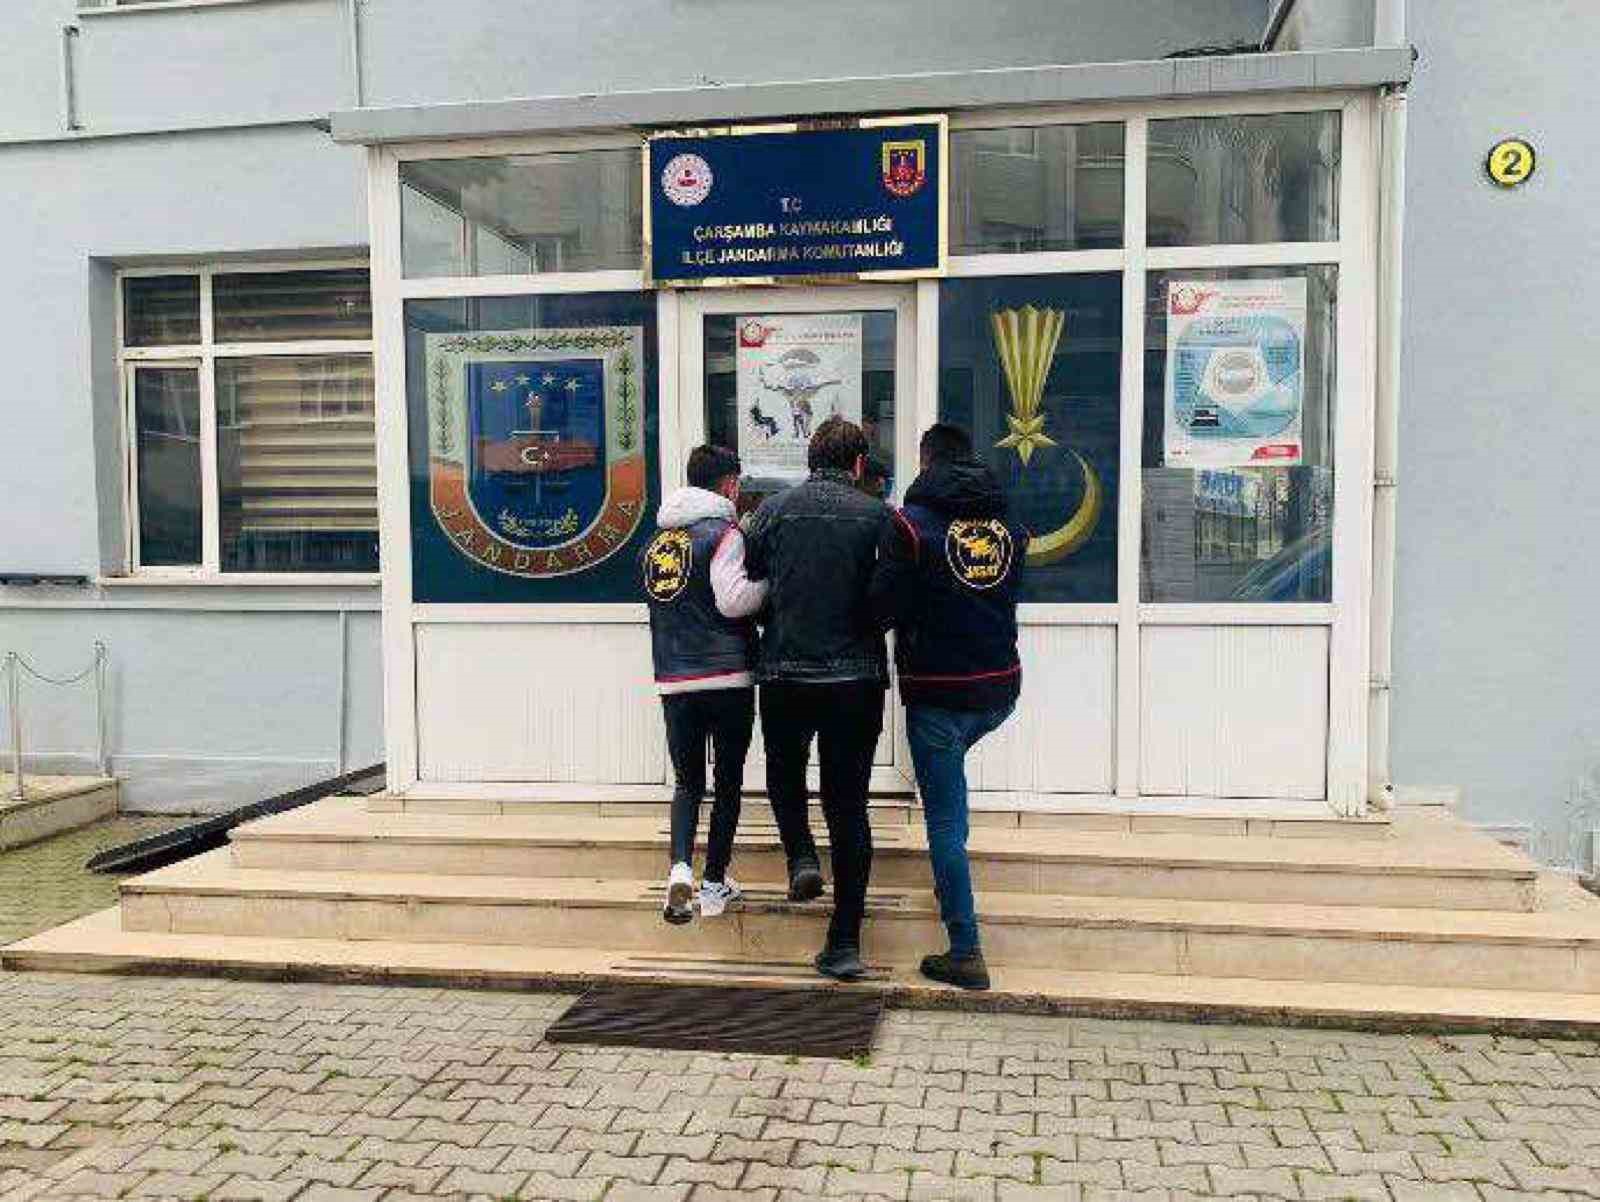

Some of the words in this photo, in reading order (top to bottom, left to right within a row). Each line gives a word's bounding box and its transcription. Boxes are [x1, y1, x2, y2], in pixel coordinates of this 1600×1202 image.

[1502, 149, 1522, 175] 2
[693, 223, 774, 243] ÇARŞAMBA
[780, 214, 893, 236] KAYMAKAMLIĞI
[717, 246, 800, 264] JANDARMA
[803, 240, 904, 260] KOMUTANLIĞI
